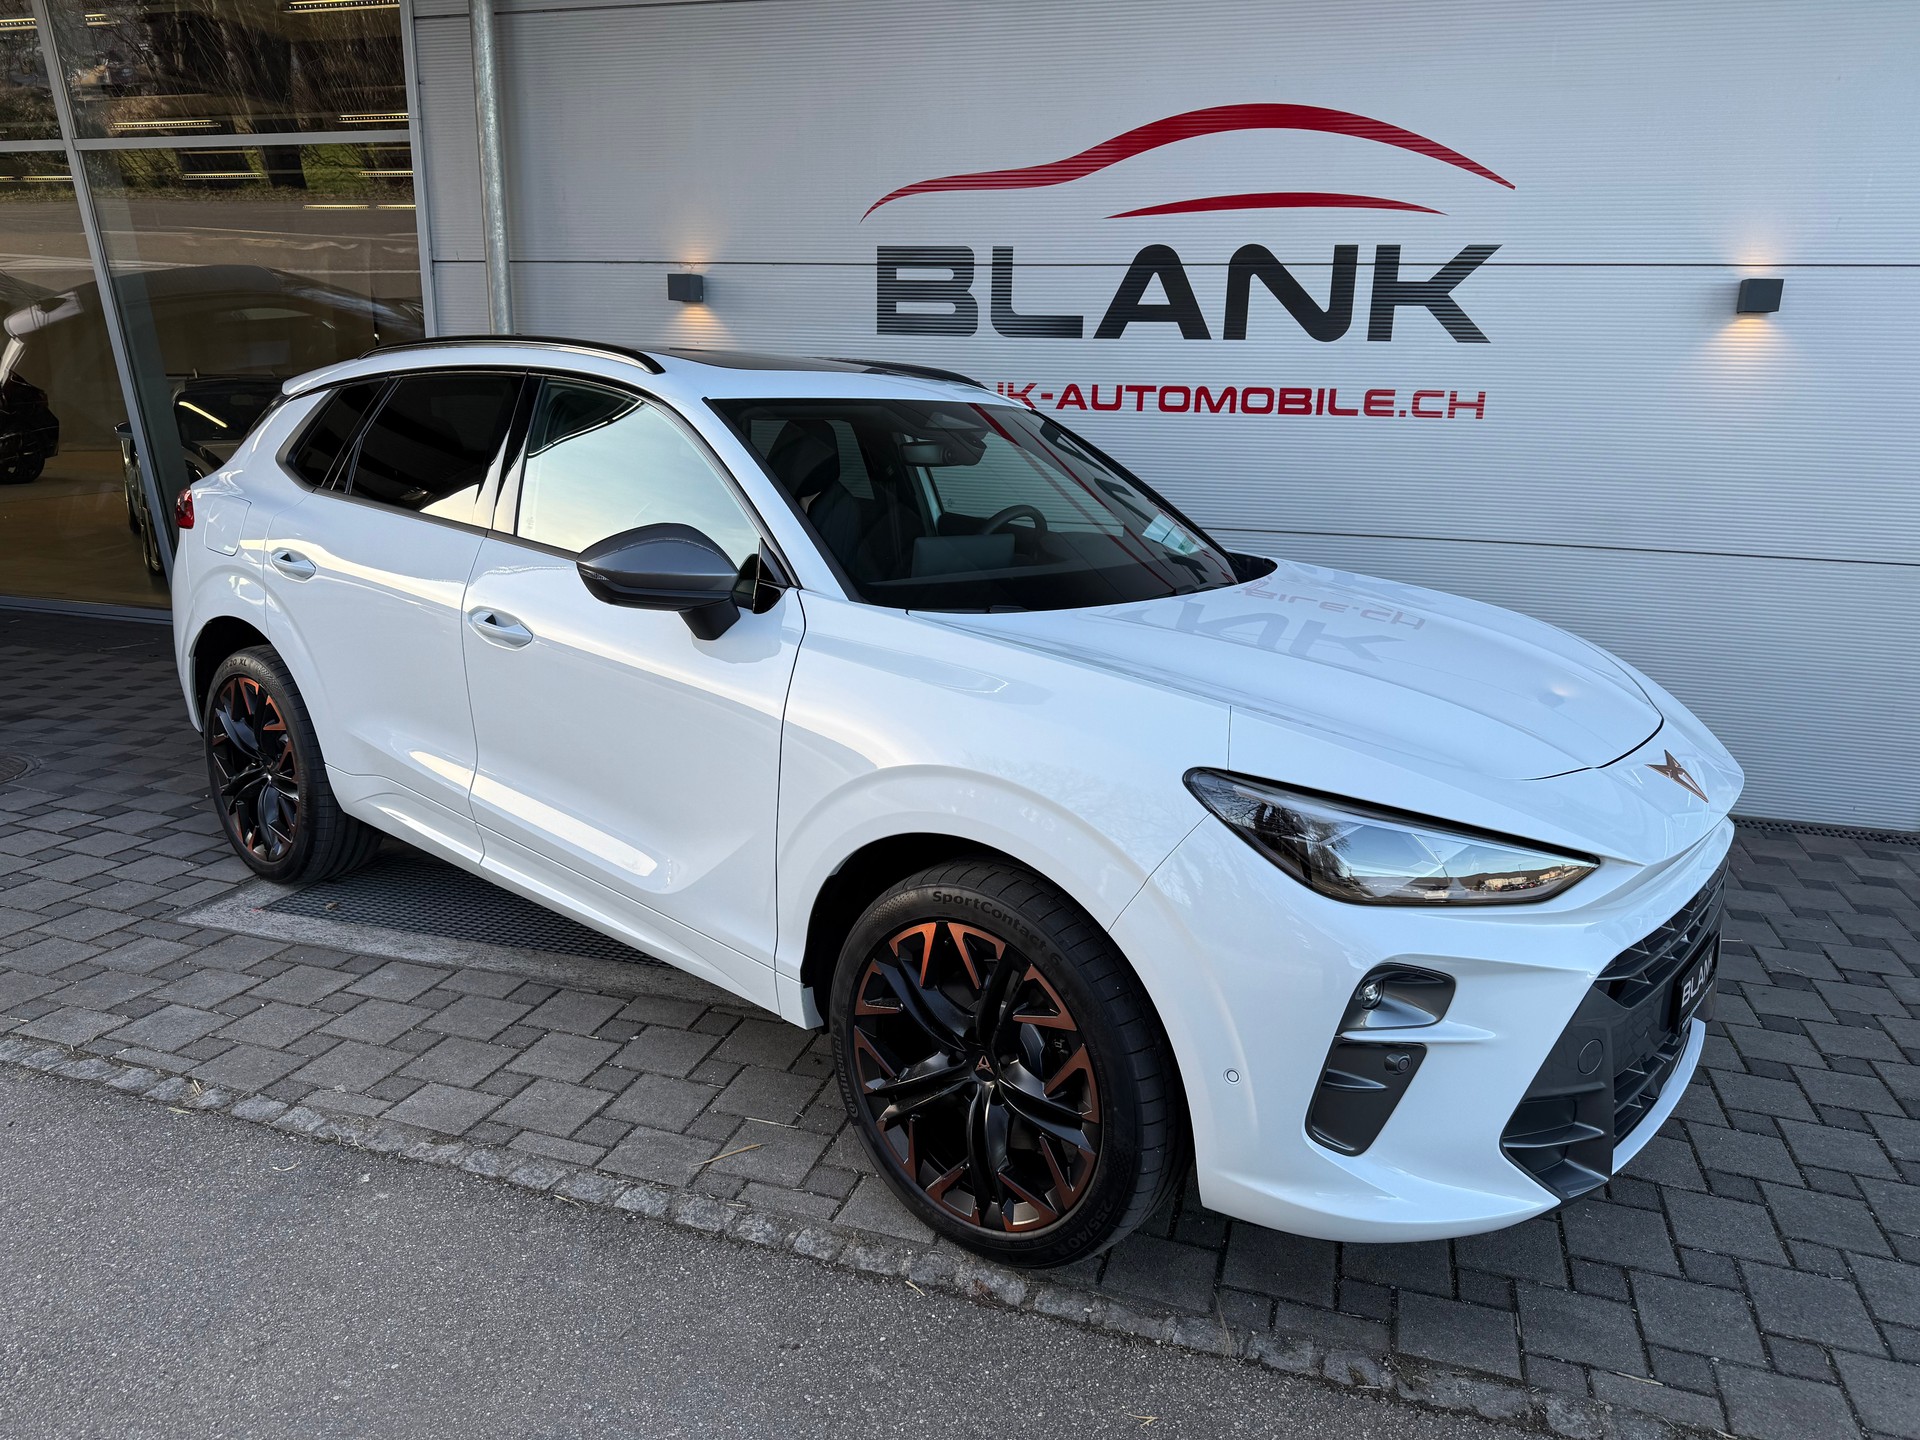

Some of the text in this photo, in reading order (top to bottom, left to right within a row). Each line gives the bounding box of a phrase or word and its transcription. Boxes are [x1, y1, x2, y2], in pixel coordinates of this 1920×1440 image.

[876, 243, 1503, 344] BLANK
[932, 890, 1063, 967] SportContact 6
[1068, 1199, 1114, 1249] 255/40
